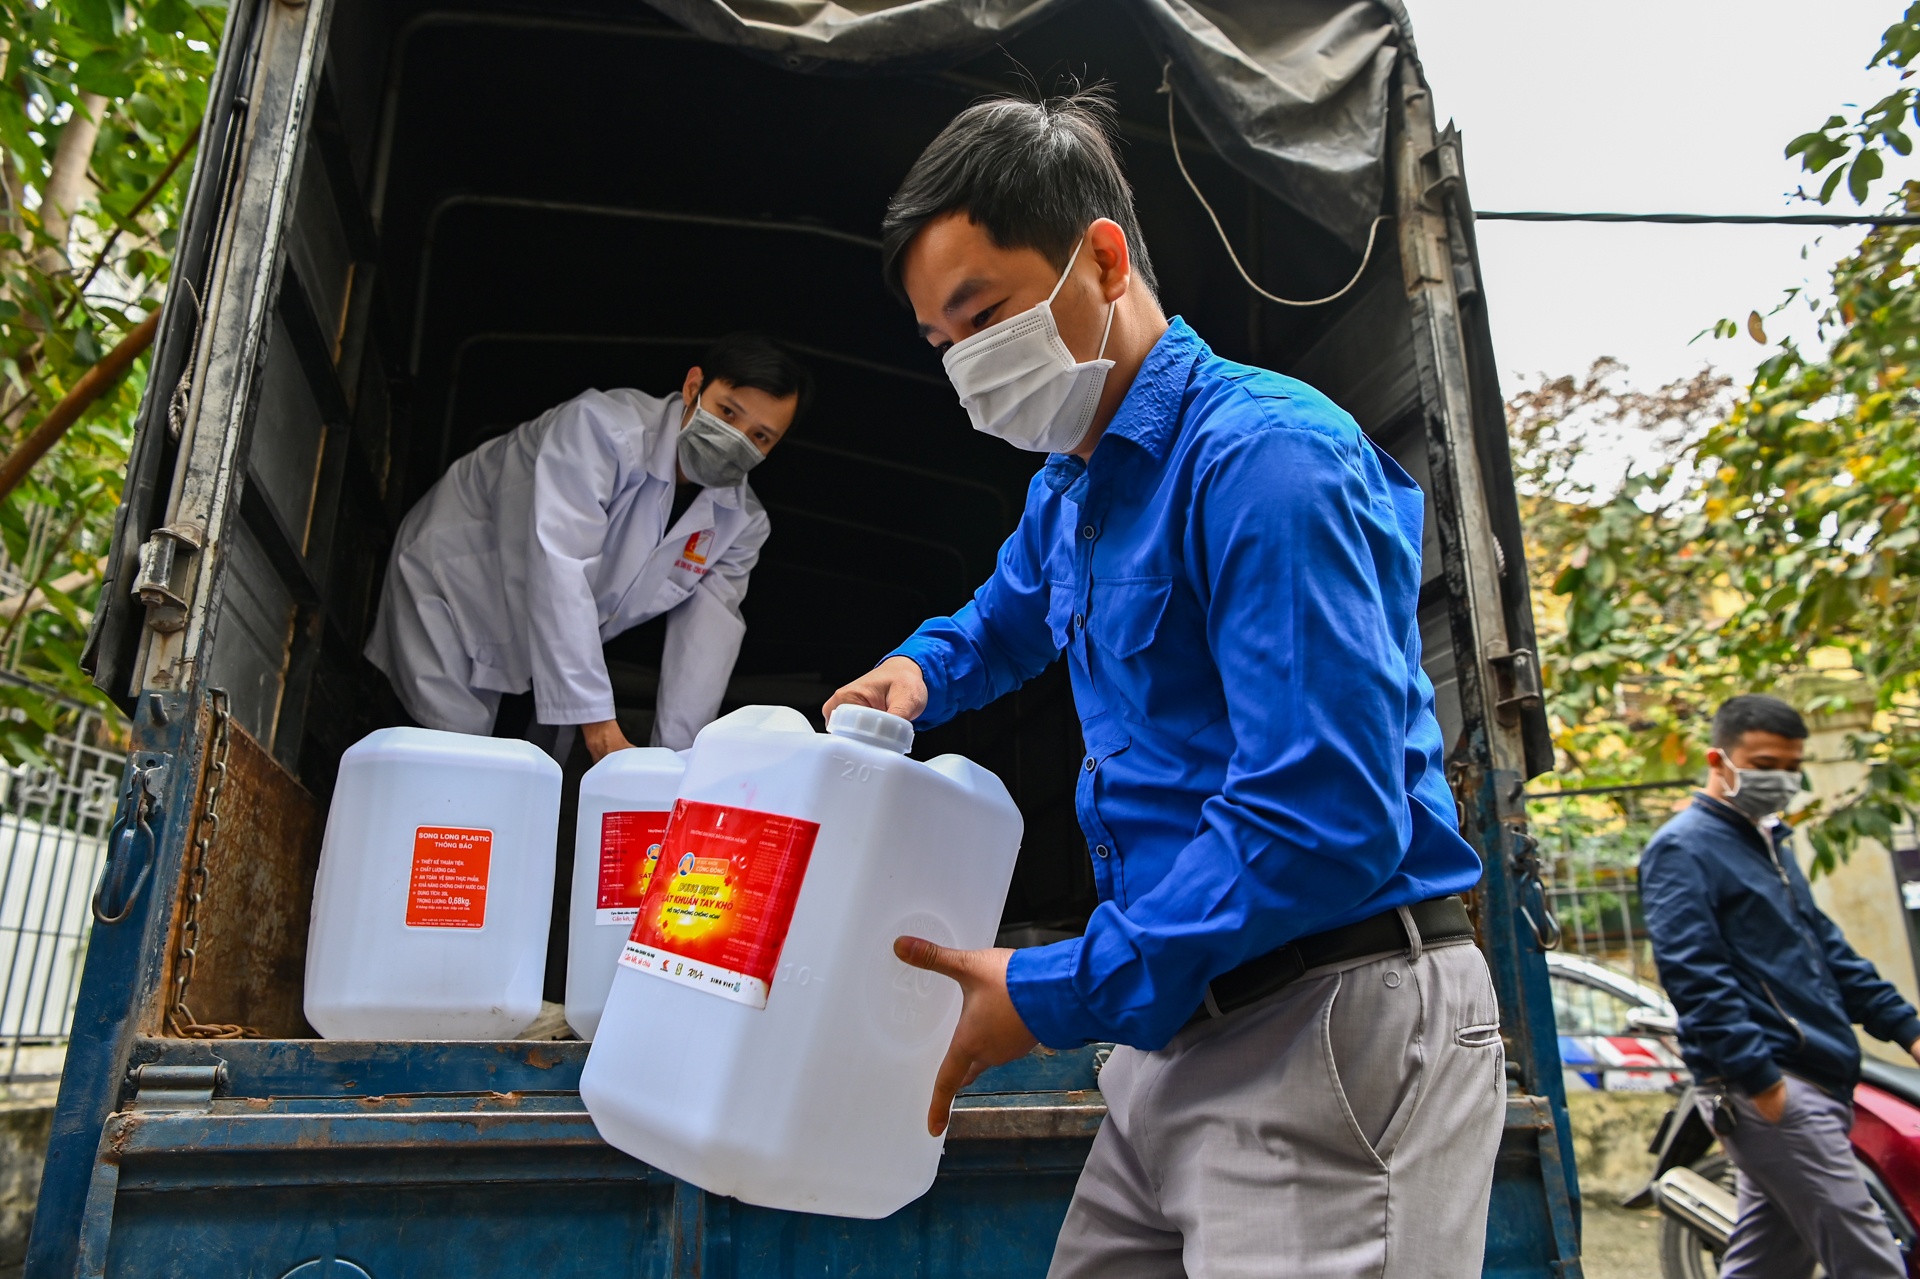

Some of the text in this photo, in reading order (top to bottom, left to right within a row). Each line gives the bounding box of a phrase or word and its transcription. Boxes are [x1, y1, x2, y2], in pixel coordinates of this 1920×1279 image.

[461, 834, 490, 842] PLASTIC
[661, 892, 674, 902] SÁT
[699, 899, 714, 908] TAY
[715, 901, 733, 910] KHÔ
